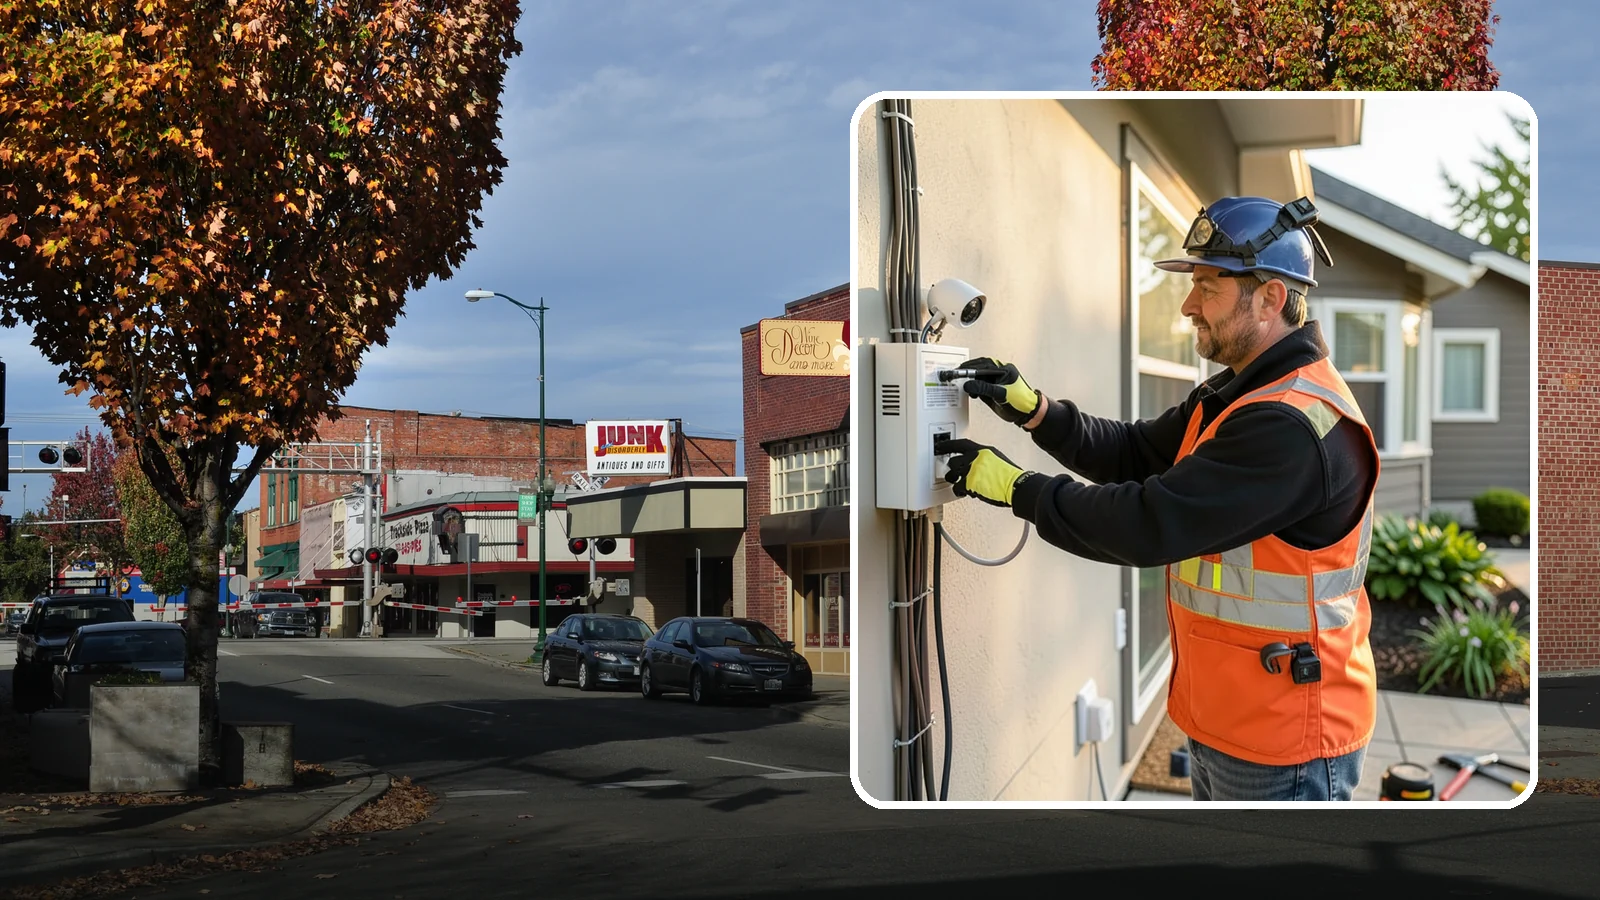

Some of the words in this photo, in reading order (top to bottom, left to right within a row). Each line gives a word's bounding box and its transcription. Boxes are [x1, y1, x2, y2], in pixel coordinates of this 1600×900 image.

[791, 325, 824, 345] Wine
[595, 425, 665, 457] JUNK
[607, 446, 646, 454] DISORDERLY
[597, 461, 628, 470] ANTIQUES
[631, 461, 644, 470] AND
[647, 460, 665, 470] GIFTS
[352, 498, 364, 510] CRO
